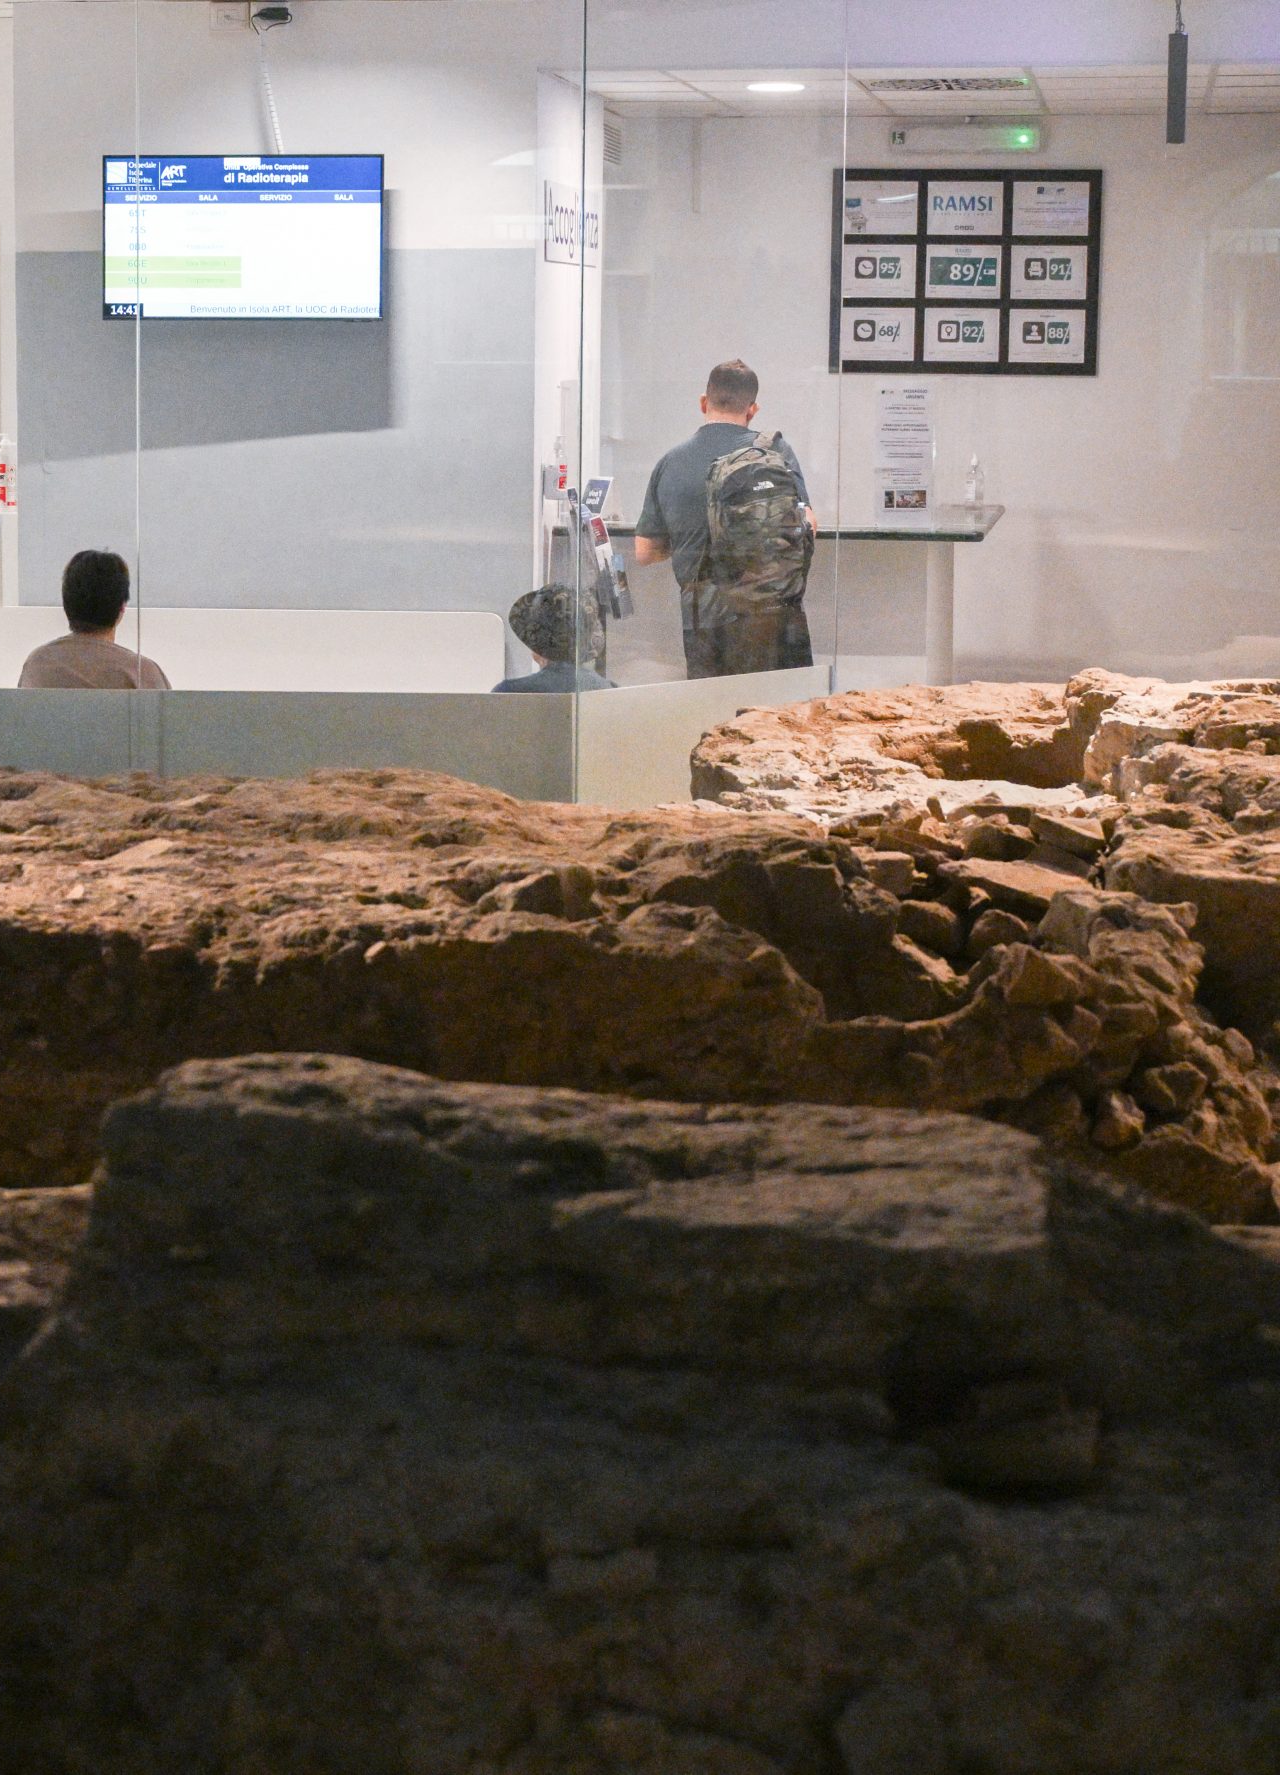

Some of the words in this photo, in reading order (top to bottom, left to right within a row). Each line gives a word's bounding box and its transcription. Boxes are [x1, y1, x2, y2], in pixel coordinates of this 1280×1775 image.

[161, 165, 187, 180] ART
[224, 172, 235, 183] di
[238, 172, 309, 186] Radioterapia
[198, 194, 219, 202] SALA
[933, 195, 993, 212] RAMSI
[190, 304, 237, 314] Benvenuto
[239, 304, 247, 314] in
[250, 304, 270, 314] Isola
[295, 304, 303, 314] la
[305, 304, 327, 314] UOC
[330, 304, 338, 314] di
